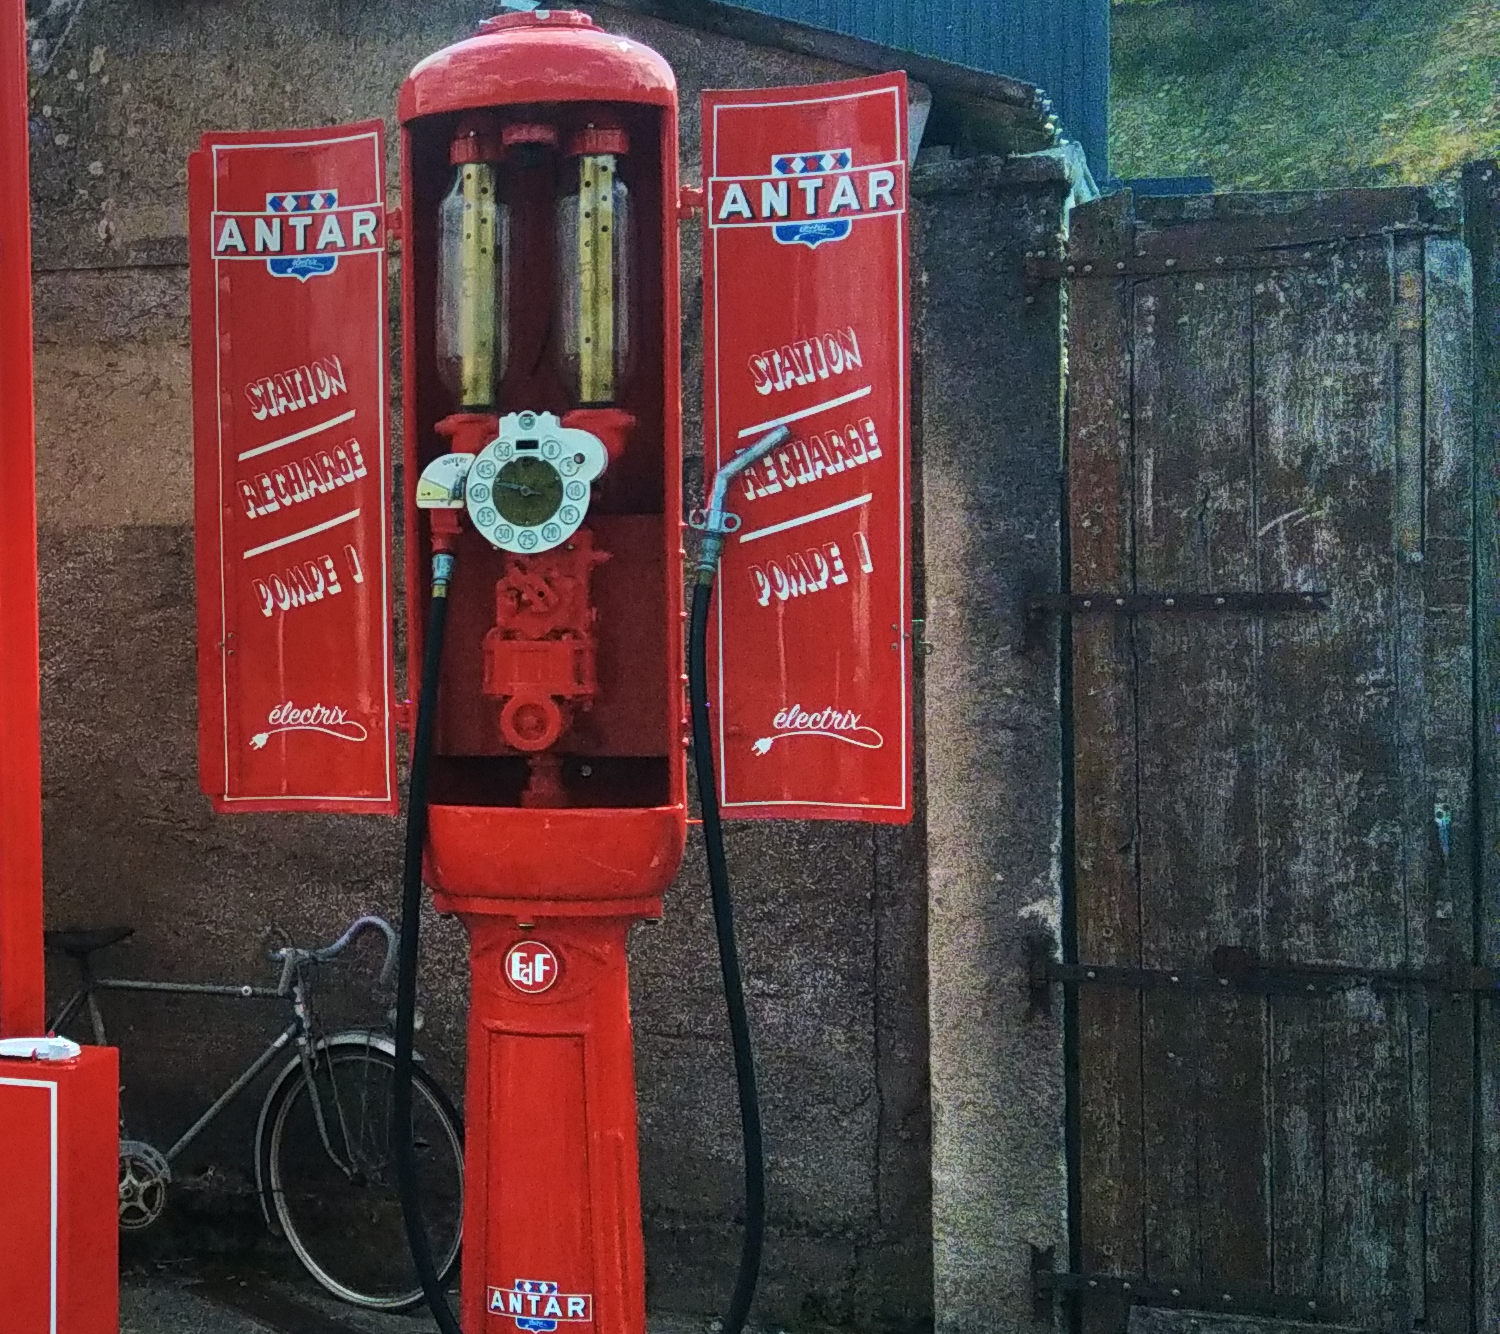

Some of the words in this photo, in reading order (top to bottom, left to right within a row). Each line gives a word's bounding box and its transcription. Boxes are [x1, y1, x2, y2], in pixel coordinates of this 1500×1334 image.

[718, 169, 897, 220] ANTAR
[217, 210, 378, 254] ANTAR
[244, 353, 347, 421] STATION
[748, 326, 863, 396] STATION
[237, 438, 368, 520] RECHARGE
[740, 416, 884, 501] RECHARGE
[252, 553, 343, 619] POMPE
[748, 542, 848, 608] POMPE
[267, 701, 348, 726] électrix
[772, 703, 862, 731] électrix
[511, 951, 551, 986] EdF
[490, 1290, 586, 1318] ANTAR
